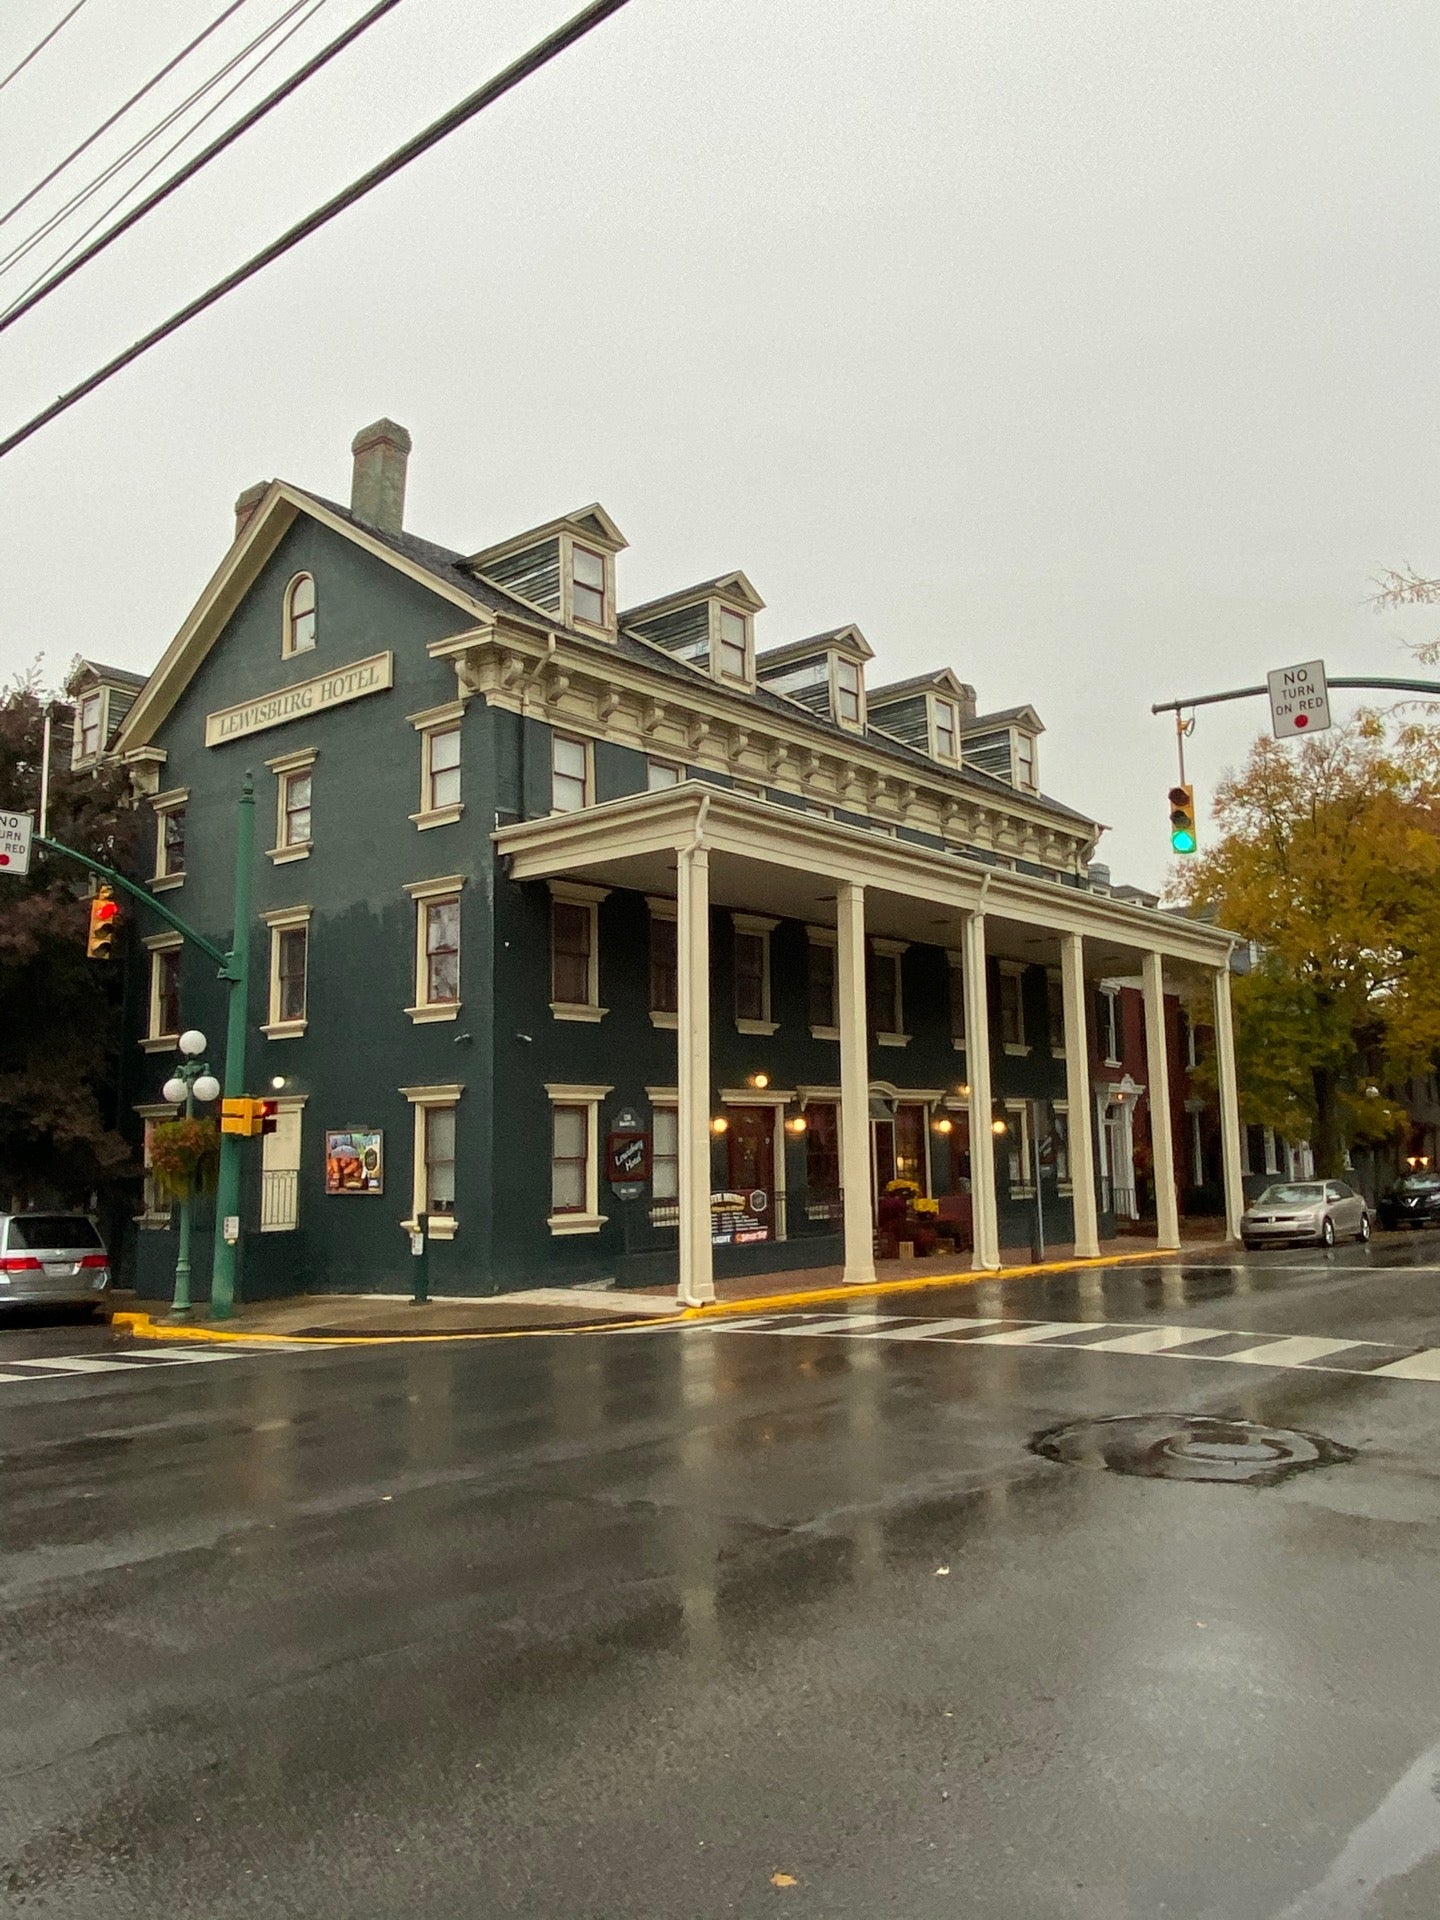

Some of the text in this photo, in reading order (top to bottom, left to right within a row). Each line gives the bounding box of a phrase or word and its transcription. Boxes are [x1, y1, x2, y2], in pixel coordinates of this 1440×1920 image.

[1284, 669, 1308, 685] NO
[1281, 684, 1315, 700] TURN
[220, 666, 379, 737] LEWISBURG HOTEL
[1276, 697, 1324, 716] ON RED
[0, 816, 19, 828] NO
[0, 830, 22, 841] URN
[5, 843, 26, 854] RED
